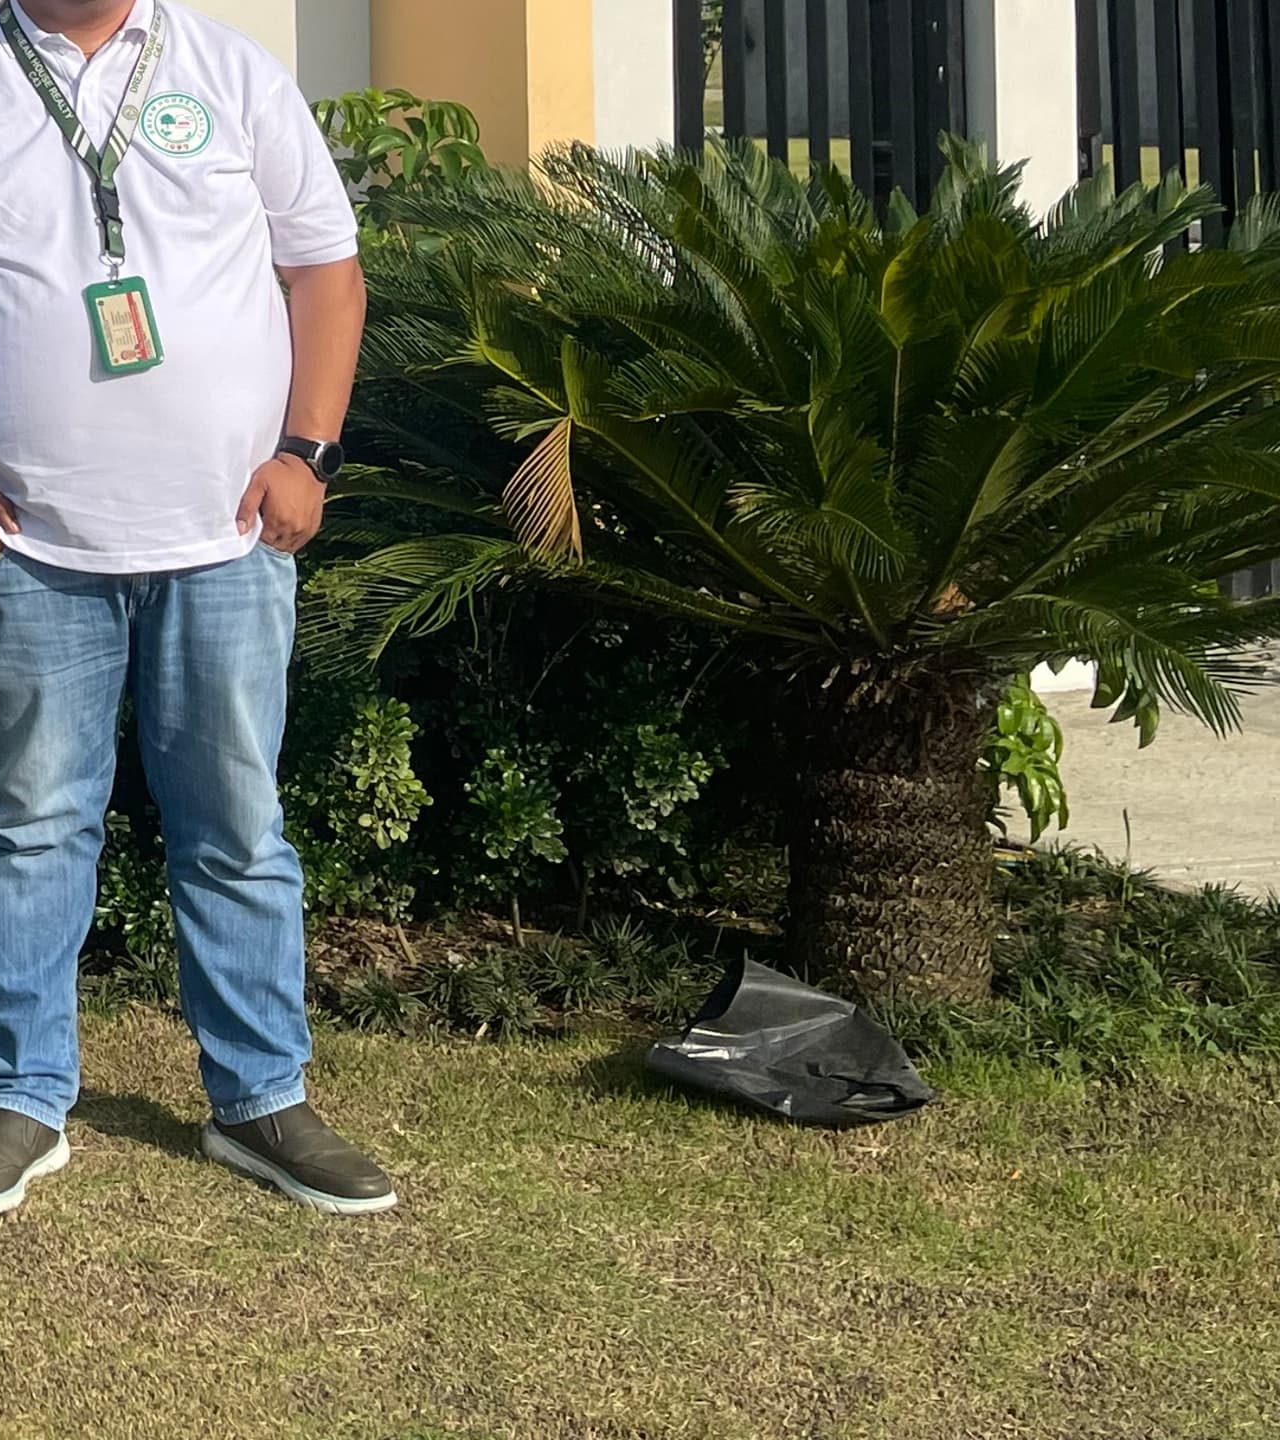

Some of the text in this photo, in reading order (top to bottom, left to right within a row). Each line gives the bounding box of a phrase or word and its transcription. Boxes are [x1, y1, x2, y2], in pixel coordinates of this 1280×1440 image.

[13, 28, 74, 119] DREAM HOUSE REALTY
[129, 62, 147, 94] DREAM
